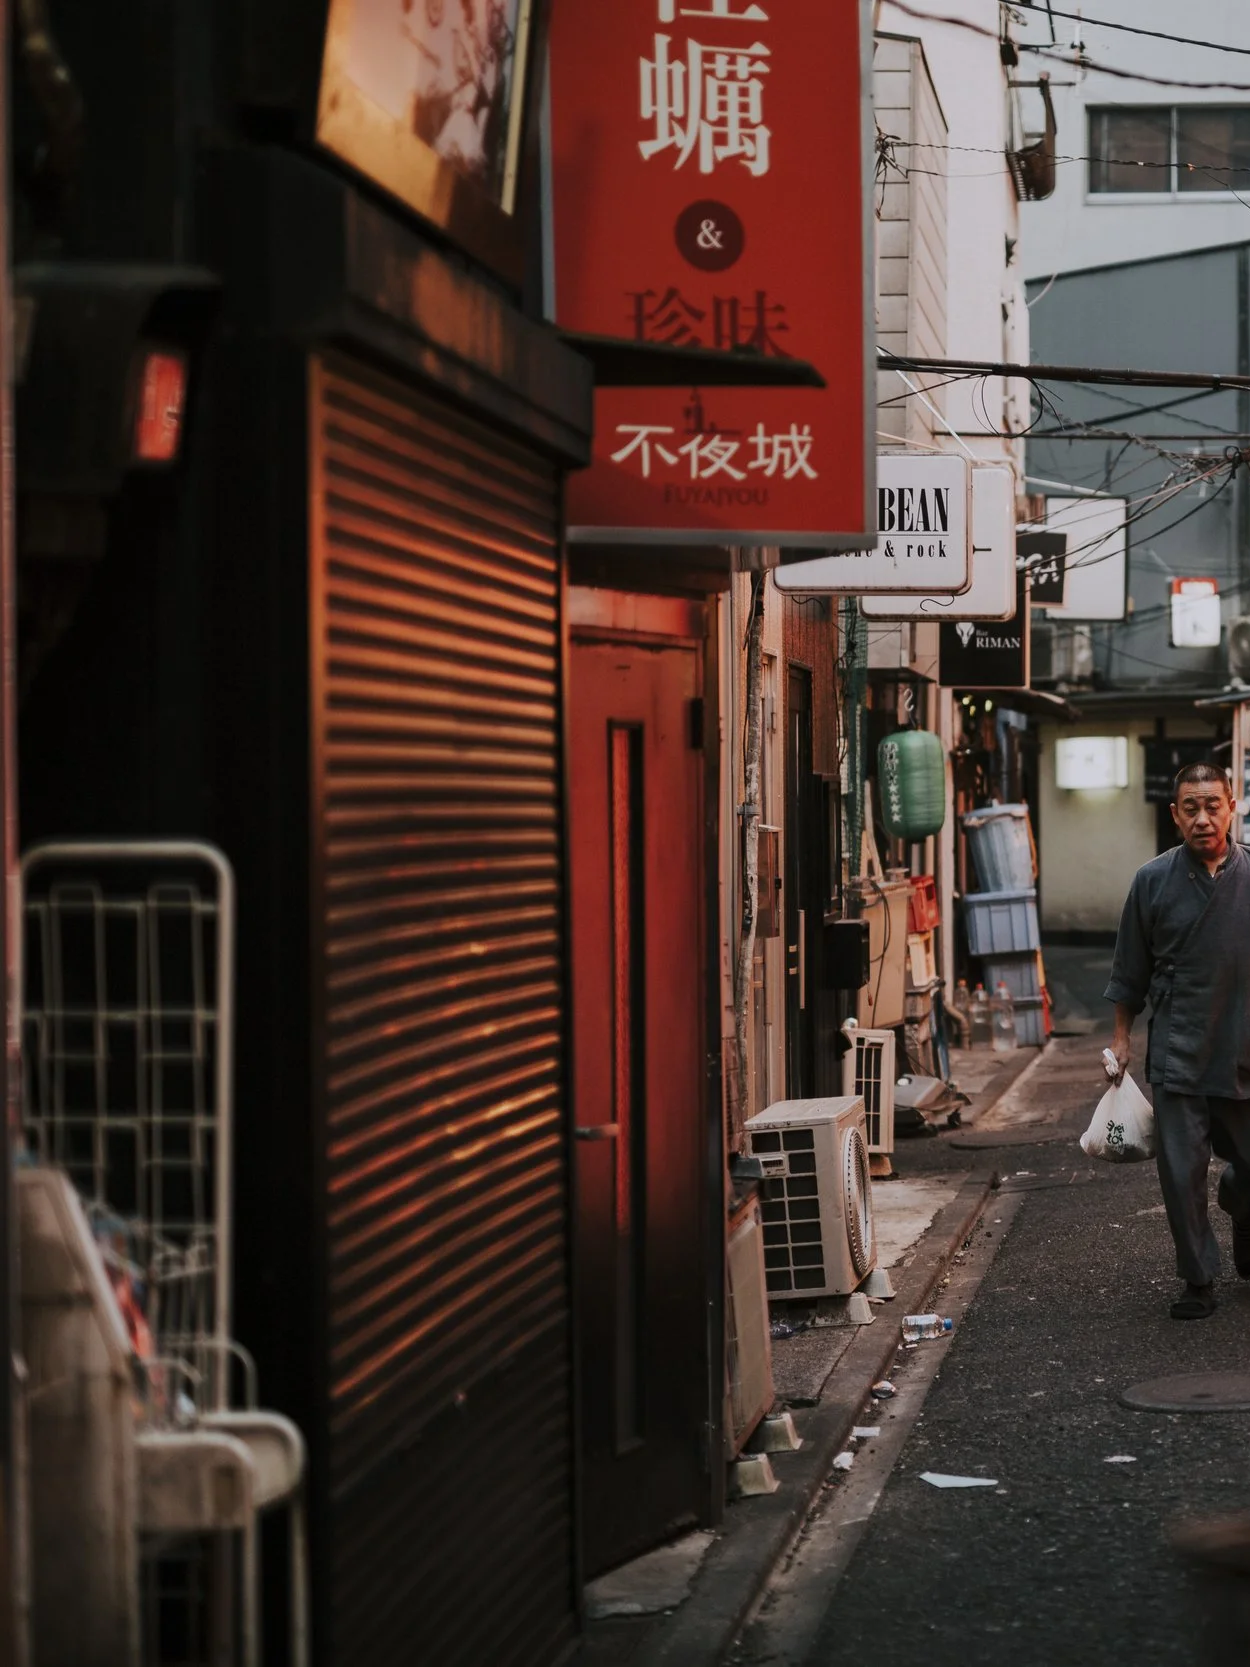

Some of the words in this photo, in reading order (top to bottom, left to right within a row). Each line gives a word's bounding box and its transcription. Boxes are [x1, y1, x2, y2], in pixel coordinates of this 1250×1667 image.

[638, 0, 771, 178] 蠣
[696, 219, 724, 249] &
[624, 287, 791, 358] 珍味
[610, 422, 819, 482] 不夜城
[884, 540, 895, 558] &
[907, 540, 947, 558] rock
[976, 637, 1021, 648] RIMAN
